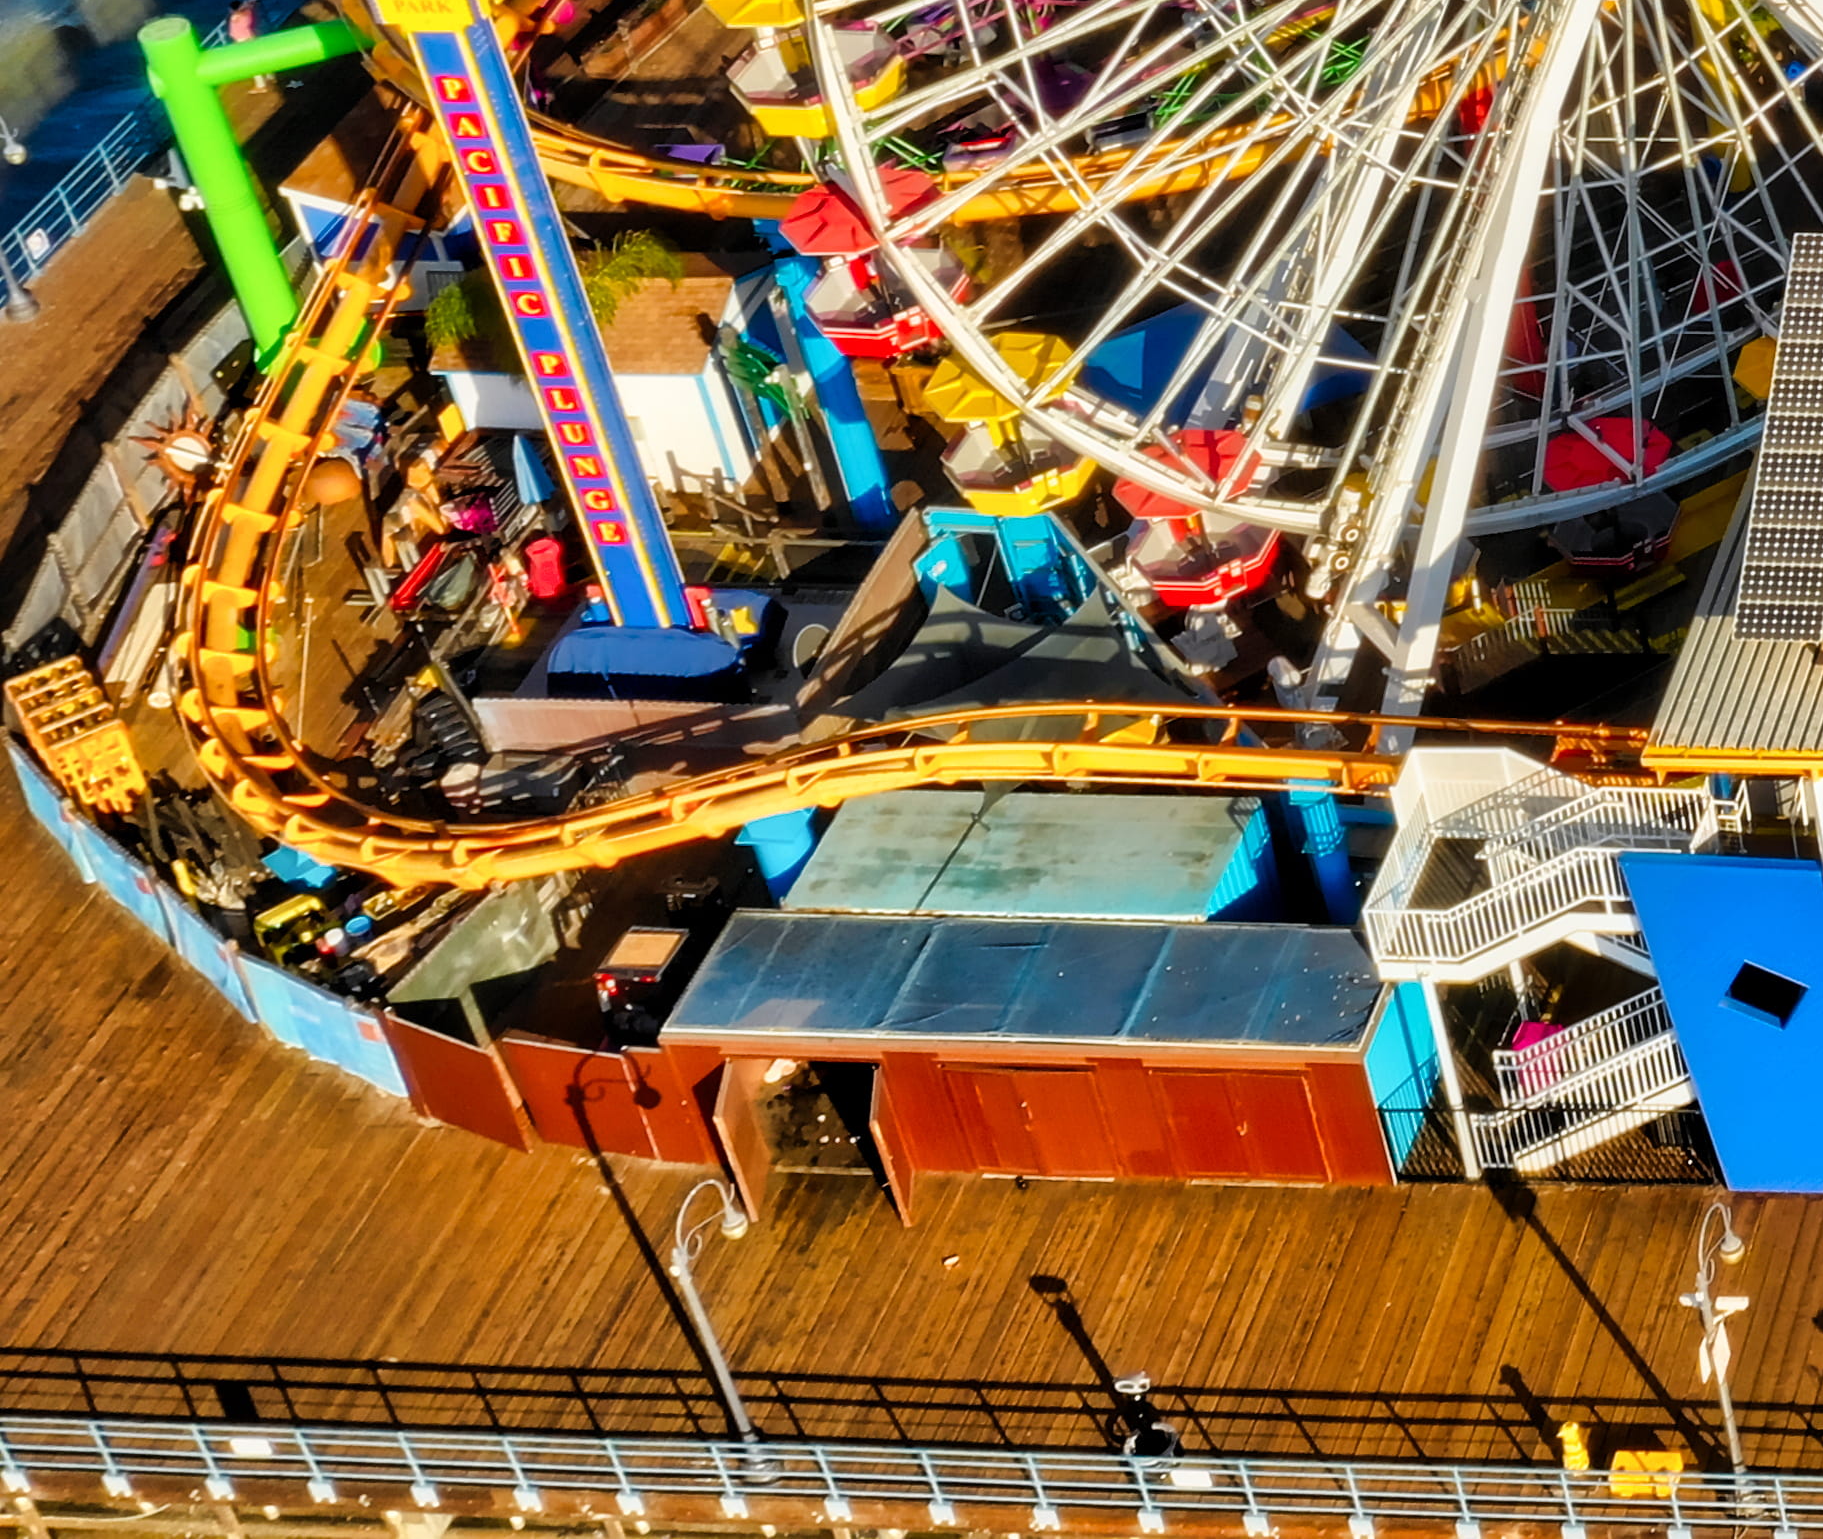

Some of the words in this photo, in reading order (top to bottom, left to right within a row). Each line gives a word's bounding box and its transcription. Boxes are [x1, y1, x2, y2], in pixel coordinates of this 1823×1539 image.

[393, 0, 454, 14] PARK
[441, 78, 542, 316] PACIFIC
[539, 353, 622, 544] PLUNGE
